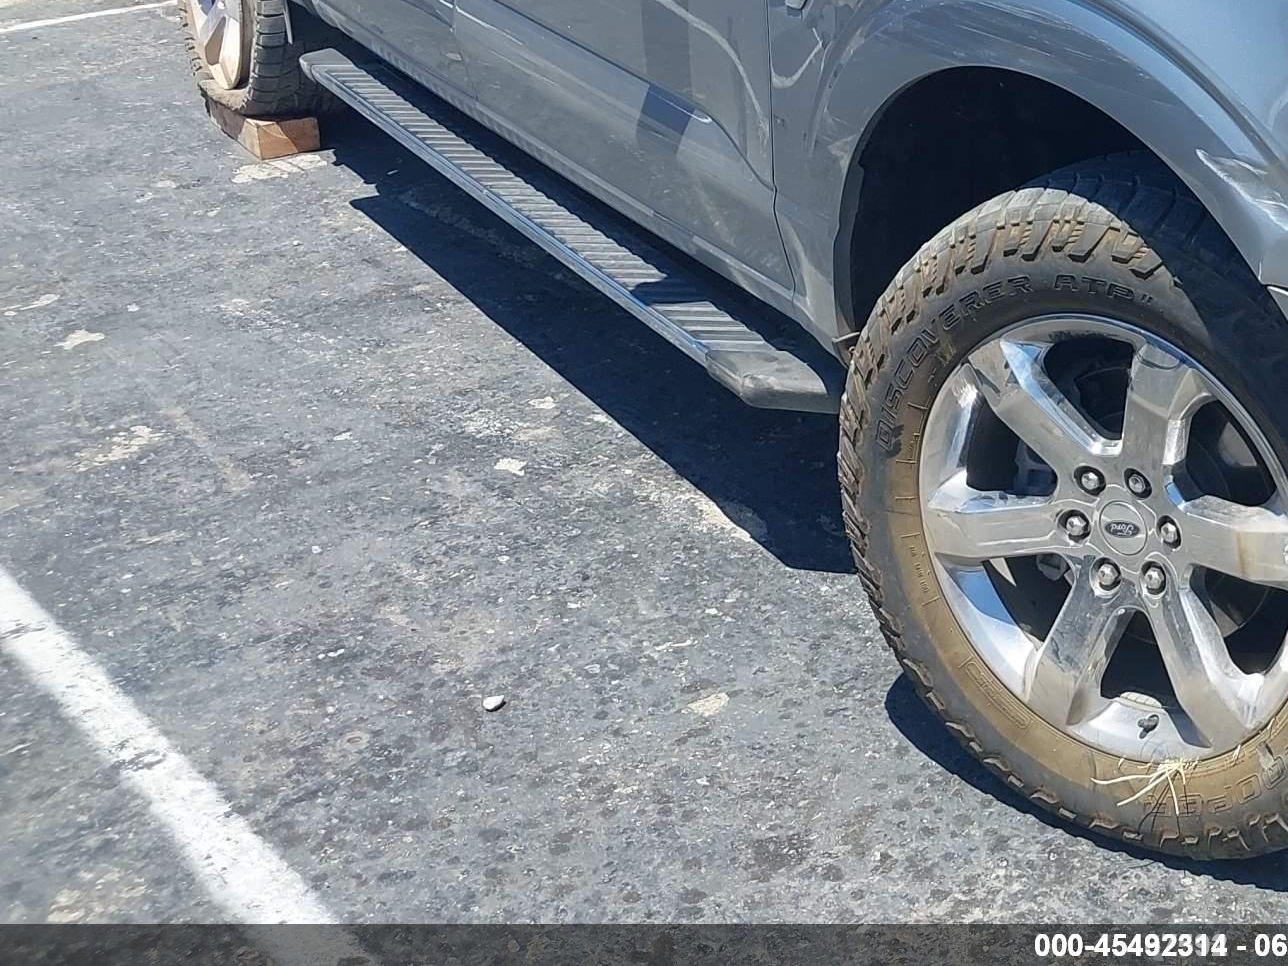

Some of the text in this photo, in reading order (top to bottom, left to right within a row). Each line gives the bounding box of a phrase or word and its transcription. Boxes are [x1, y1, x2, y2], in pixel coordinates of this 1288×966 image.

[874, 275, 1034, 452] DISCOVERER
[1054, 273, 1135, 302] ATP
[1109, 522, 1135, 536] Ford
